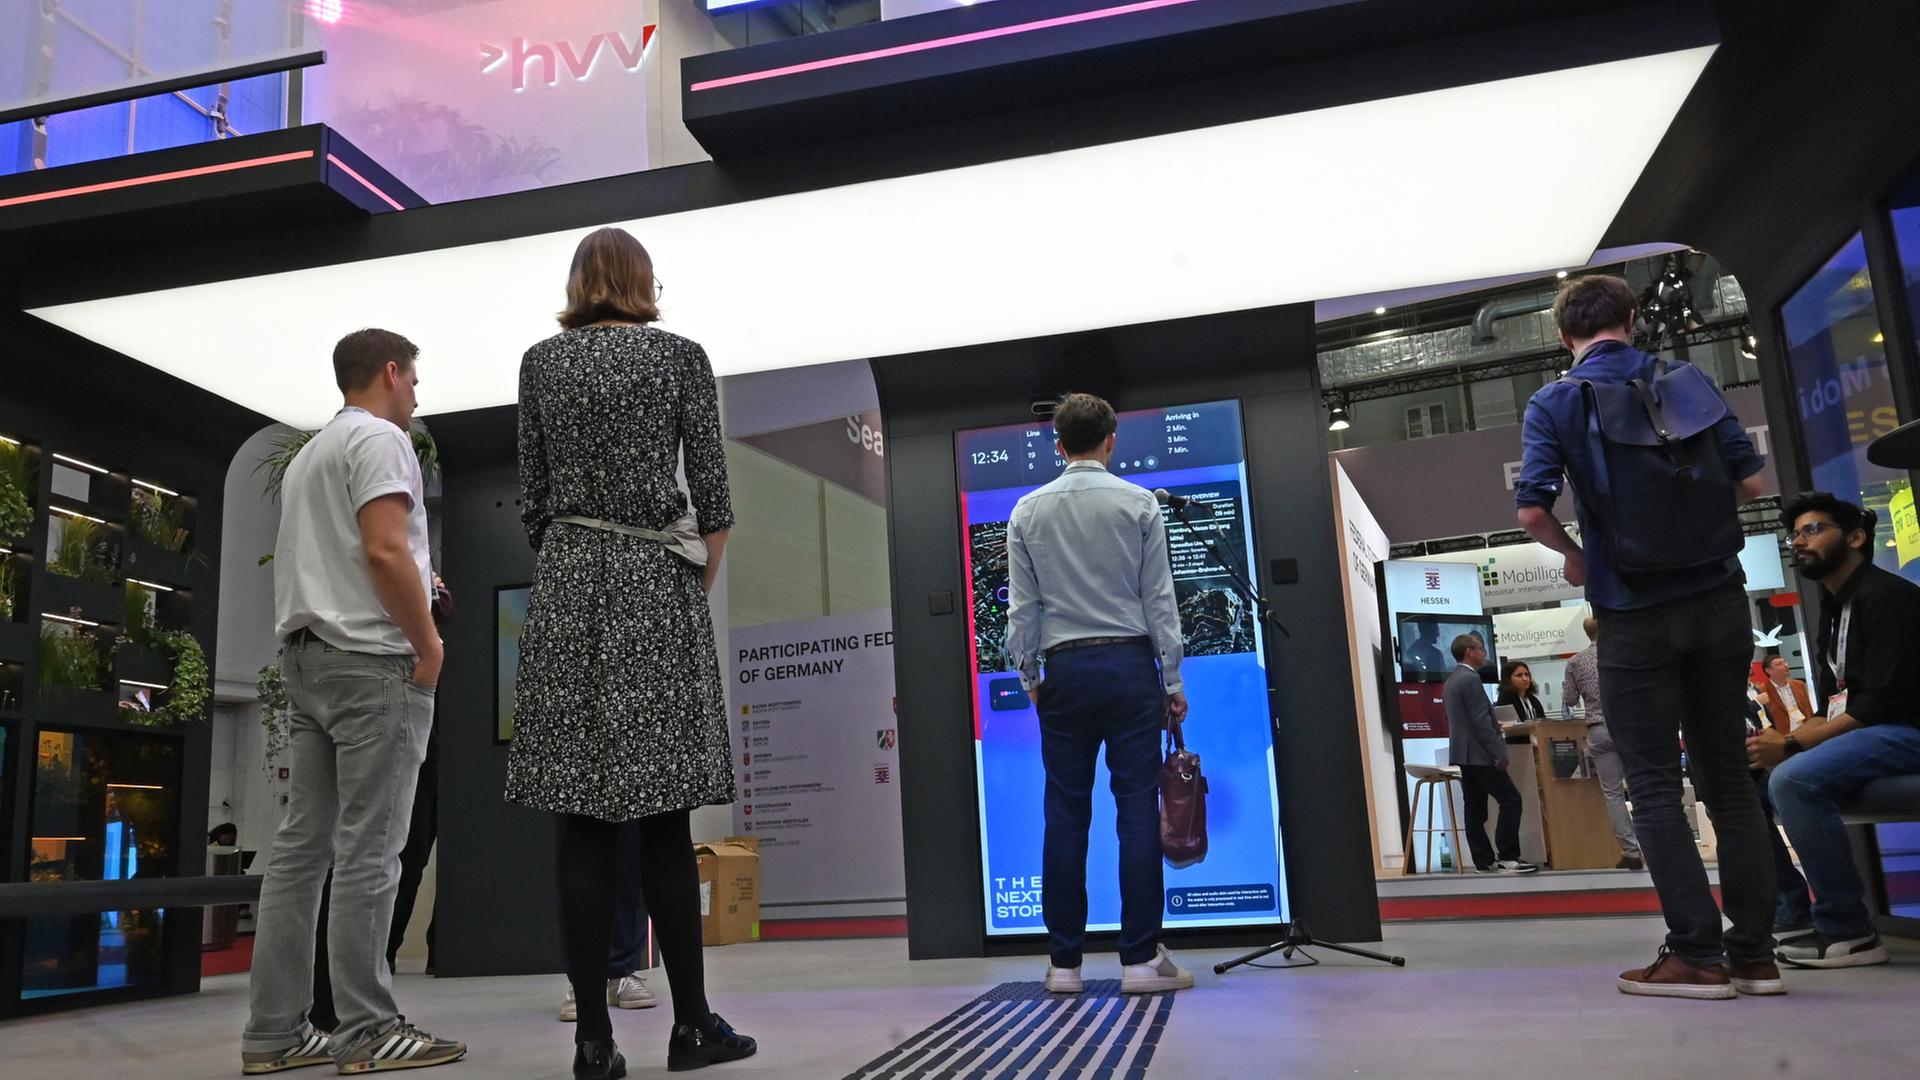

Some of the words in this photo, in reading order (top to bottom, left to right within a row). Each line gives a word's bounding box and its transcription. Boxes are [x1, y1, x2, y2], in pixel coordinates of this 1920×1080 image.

[1165, 413, 1192, 421] Arriving
[971, 449, 1008, 465] 12:34
[1420, 597, 1450, 605] HESSEN
[1501, 629, 1564, 643] Mobilligence
[739, 636, 859, 663] PARTICIPATING
[864, 631, 895, 647] FED
[740, 669, 760, 684] OF
[765, 659, 845, 681] GERMANY
[995, 876, 1042, 889] THE
[996, 890, 1042, 903] NEXT
[997, 905, 1042, 918] STOP
